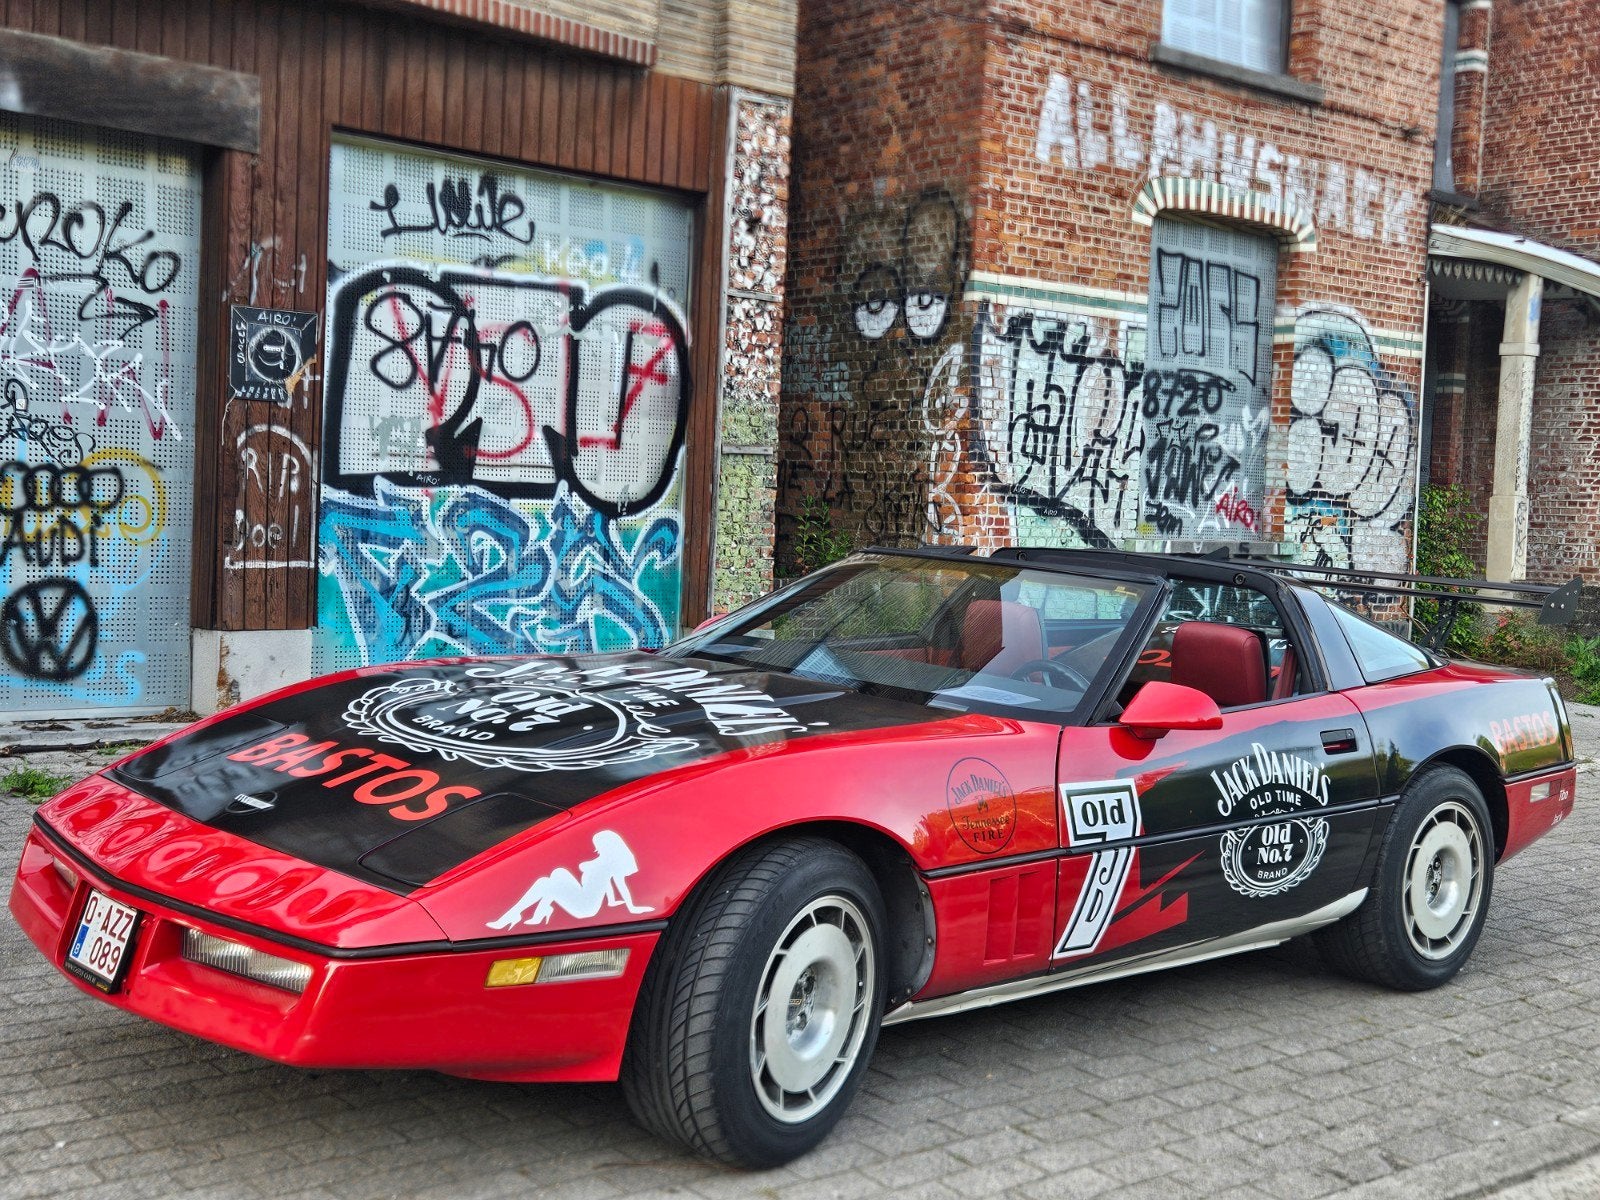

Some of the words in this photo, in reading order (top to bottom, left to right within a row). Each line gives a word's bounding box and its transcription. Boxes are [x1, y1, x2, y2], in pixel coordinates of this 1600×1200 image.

[491, 690, 594, 717] Old
[411, 715, 496, 741] BRAND
[1489, 710, 1557, 756] BASTOS
[226, 733, 483, 822] BASTOS
[1210, 755, 1260, 817] JACK
[1251, 742, 1331, 806] DANIEL'S
[951, 780, 974, 805] JACK
[1250, 792, 1272, 810] OLD
[1275, 789, 1302, 807] TIME
[1081, 797, 1127, 827] Old
[973, 828, 1006, 843] FIRE
[1261, 823, 1292, 846] Old
[1256, 843, 1294, 865] No.7
[1257, 866, 1289, 880] BRAND
[73, 942, 82, 956] B
[88, 936, 121, 976] 089
